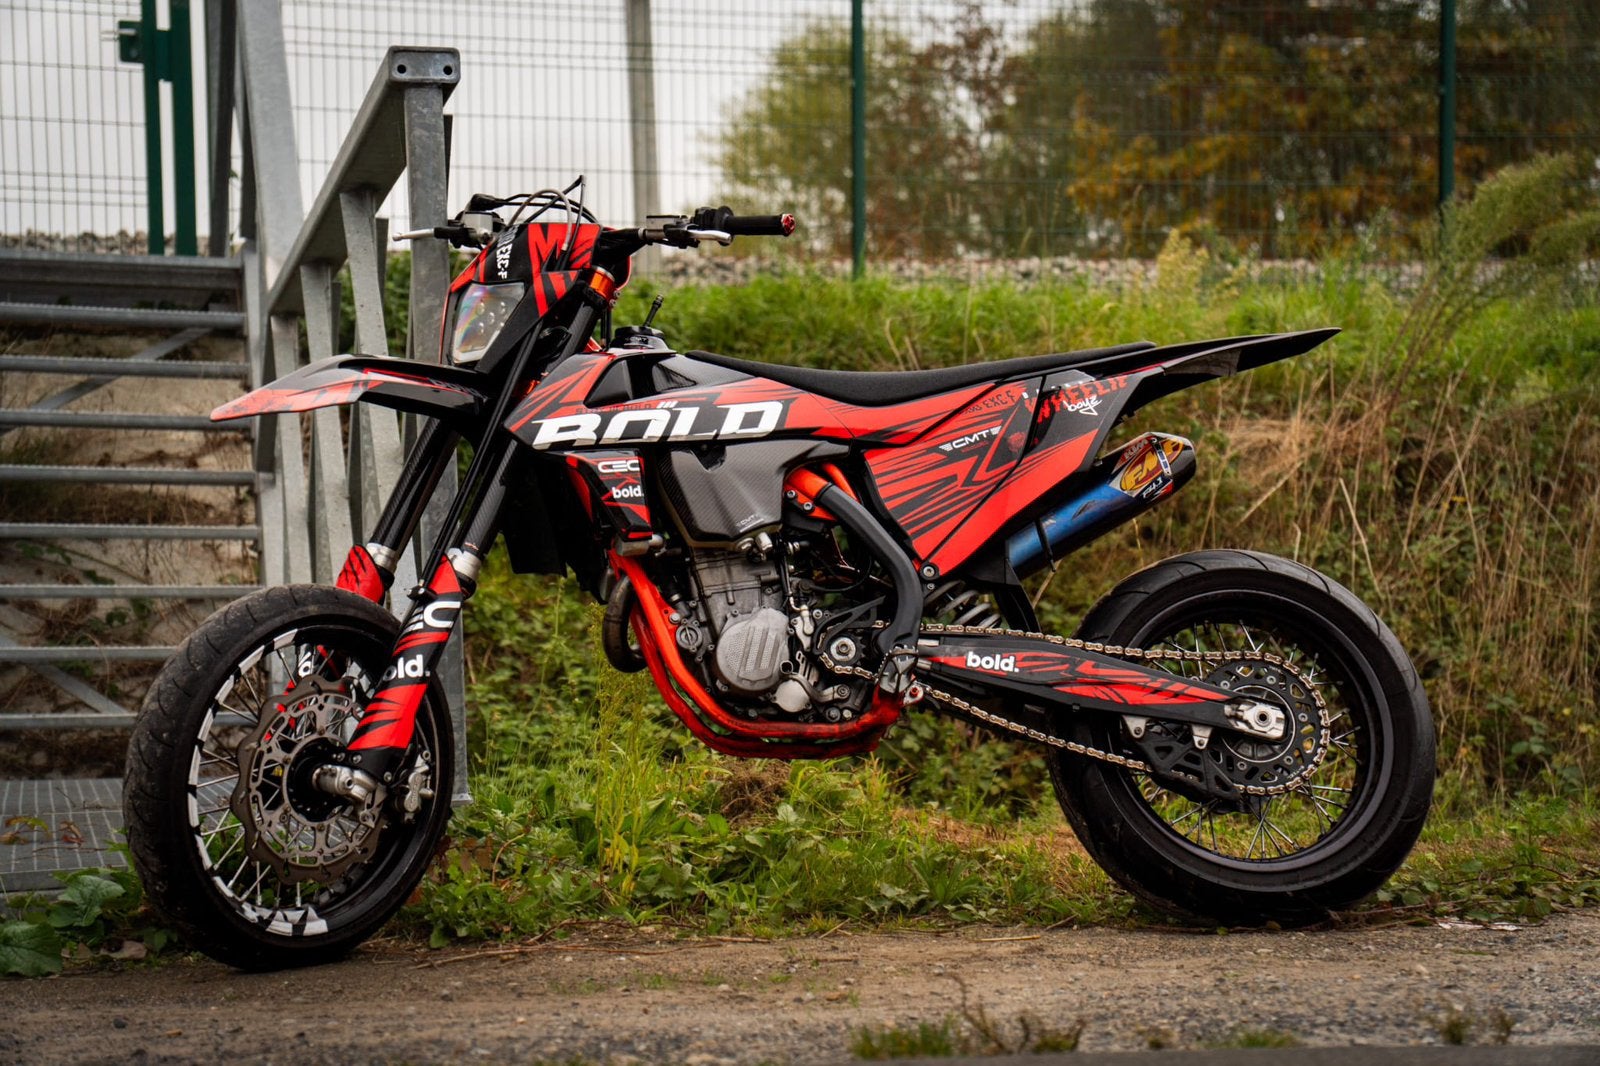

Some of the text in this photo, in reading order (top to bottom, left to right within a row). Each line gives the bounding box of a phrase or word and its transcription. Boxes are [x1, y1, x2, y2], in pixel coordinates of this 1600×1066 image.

[1063, 394, 1103, 416] boyz
[532, 400, 783, 450] BOLD
[952, 429, 989, 449] CMT
[383, 654, 430, 682] old.
[966, 651, 1020, 673] bold.
